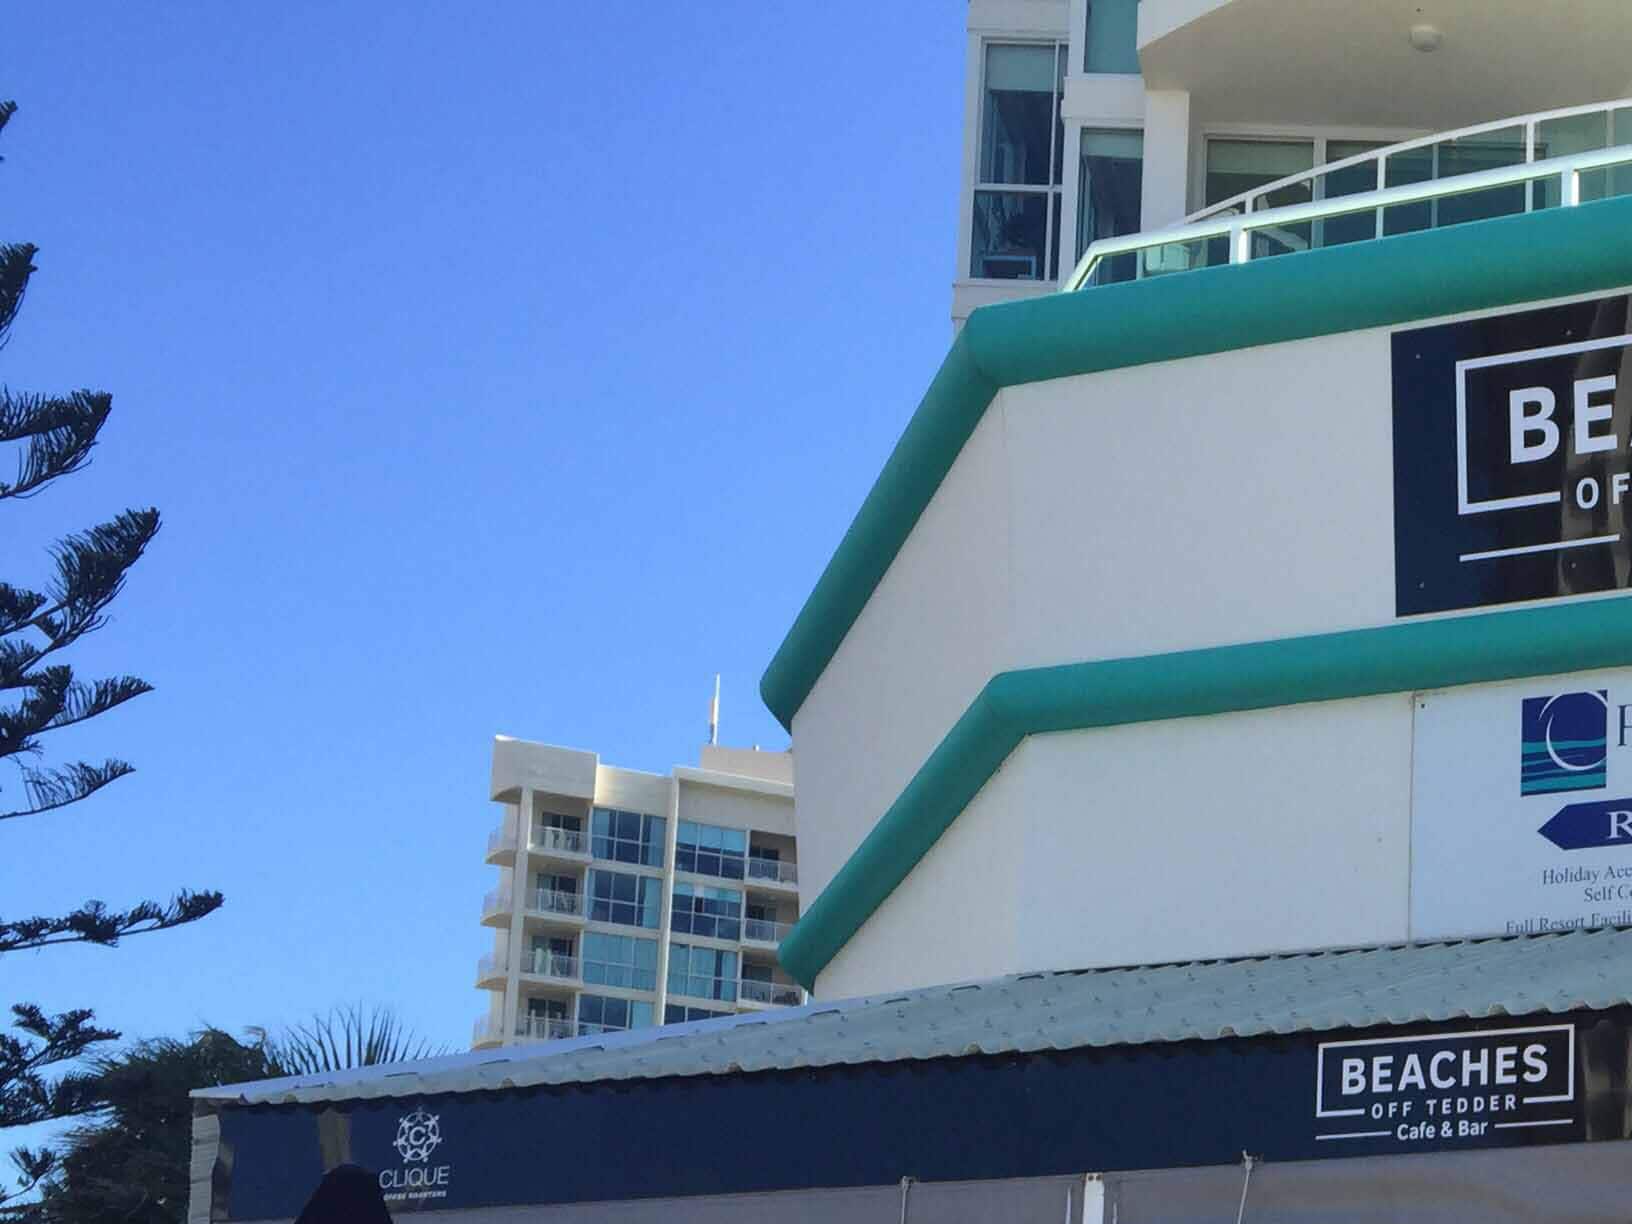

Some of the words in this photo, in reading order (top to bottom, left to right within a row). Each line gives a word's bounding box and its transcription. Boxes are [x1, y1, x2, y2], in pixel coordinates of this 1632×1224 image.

[1543, 868, 1600, 886] Holiday
[1584, 885, 1615, 903] Self
[1505, 918, 1534, 934] Full
[1538, 914, 1585, 932] Resort
[1341, 1043, 1549, 1095] BEACHES
[1371, 1102, 1412, 1119] OFF
[1426, 1094, 1517, 1116] TEDDER
[1396, 1122, 1436, 1141] Cafe
[1440, 1122, 1453, 1138] &
[1458, 1119, 1488, 1137] Bar
[378, 1165, 451, 1189] CLIQUE
